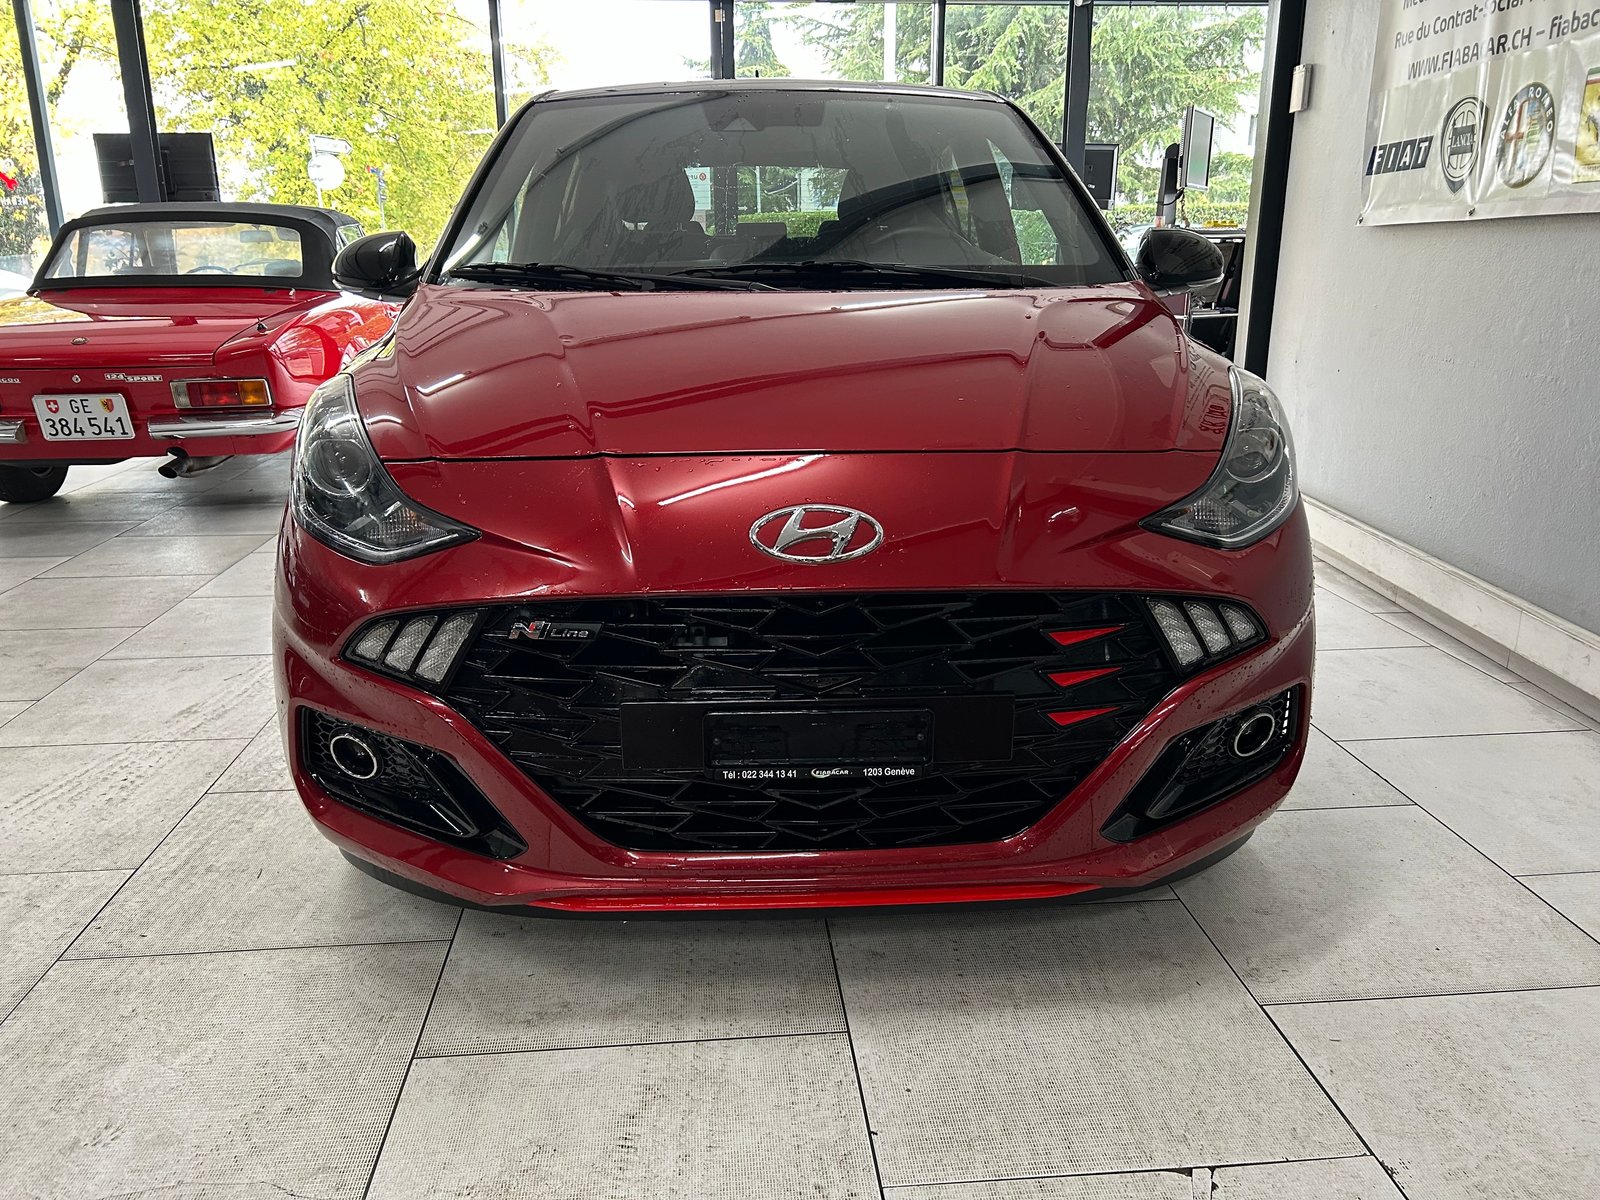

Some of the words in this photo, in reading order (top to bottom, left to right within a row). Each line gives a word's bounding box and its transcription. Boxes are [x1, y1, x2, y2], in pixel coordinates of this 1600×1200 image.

[1394, 31, 1414, 49] Rue
[1416, 21, 1431, 41] du
[1407, 26, 1532, 80] WWW.FIABAAR.CH
[1528, 86, 1553, 132] ROMEO
[1373, 141, 1429, 175] FIAT
[69, 399, 92, 414] GE
[45, 417, 85, 437] 384
[87, 416, 129, 436] 541
[550, 628, 589, 638] Line
[723, 770, 735, 779] Tél
[741, 770, 757, 779] 022
[759, 770, 773, 778] 344
[775, 770, 785, 778] 13
[787, 770, 797, 778] 41
[863, 768, 882, 776] 1203
[884, 767, 915, 776] Genève
